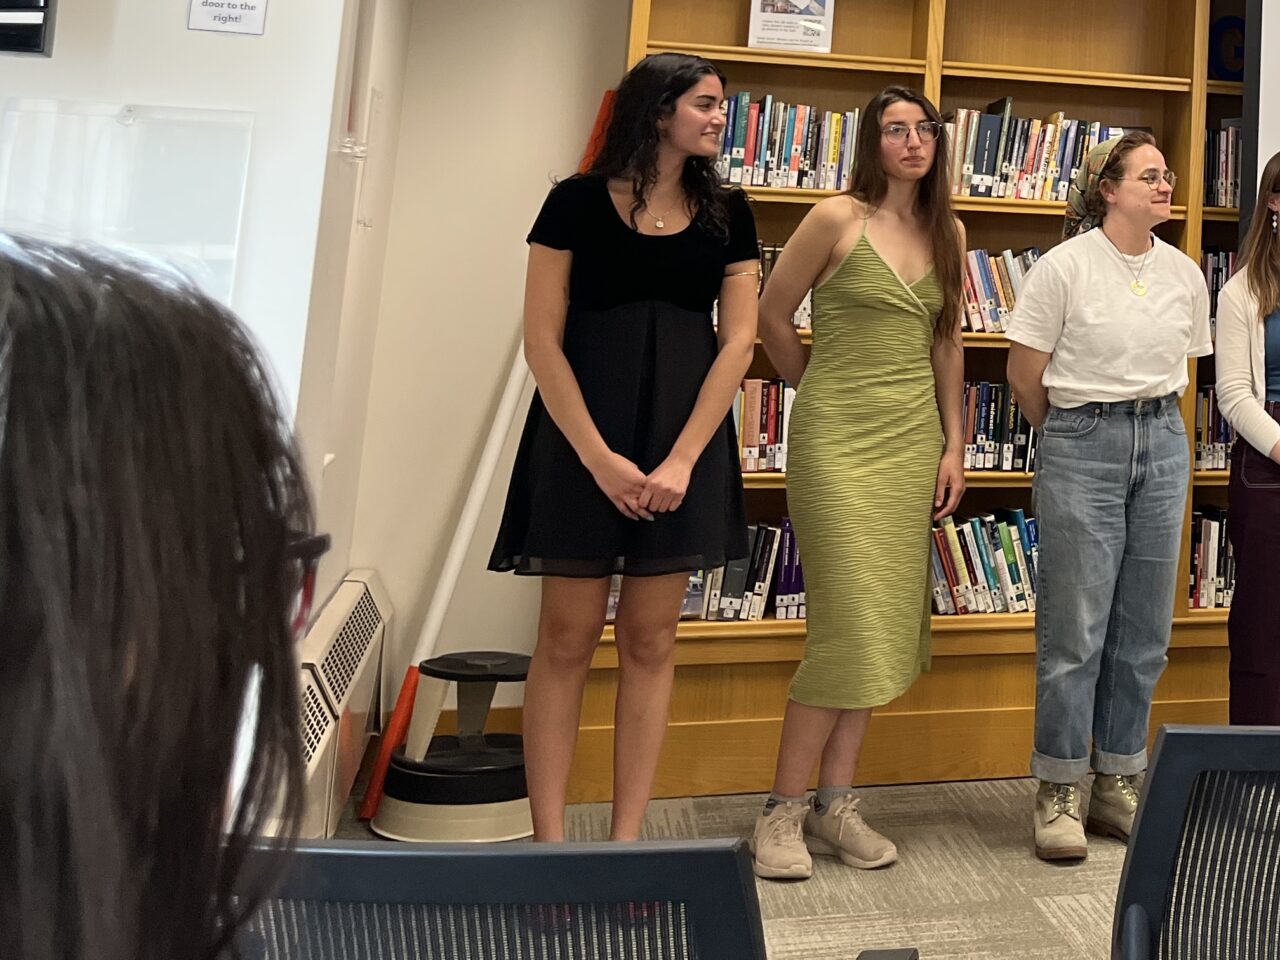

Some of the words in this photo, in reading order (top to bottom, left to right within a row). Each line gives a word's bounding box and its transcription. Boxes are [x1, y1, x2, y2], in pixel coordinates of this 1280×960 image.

[227, 2, 237, 10] to
[240, 2, 256, 11] the
[213, 13, 242, 24] right!
